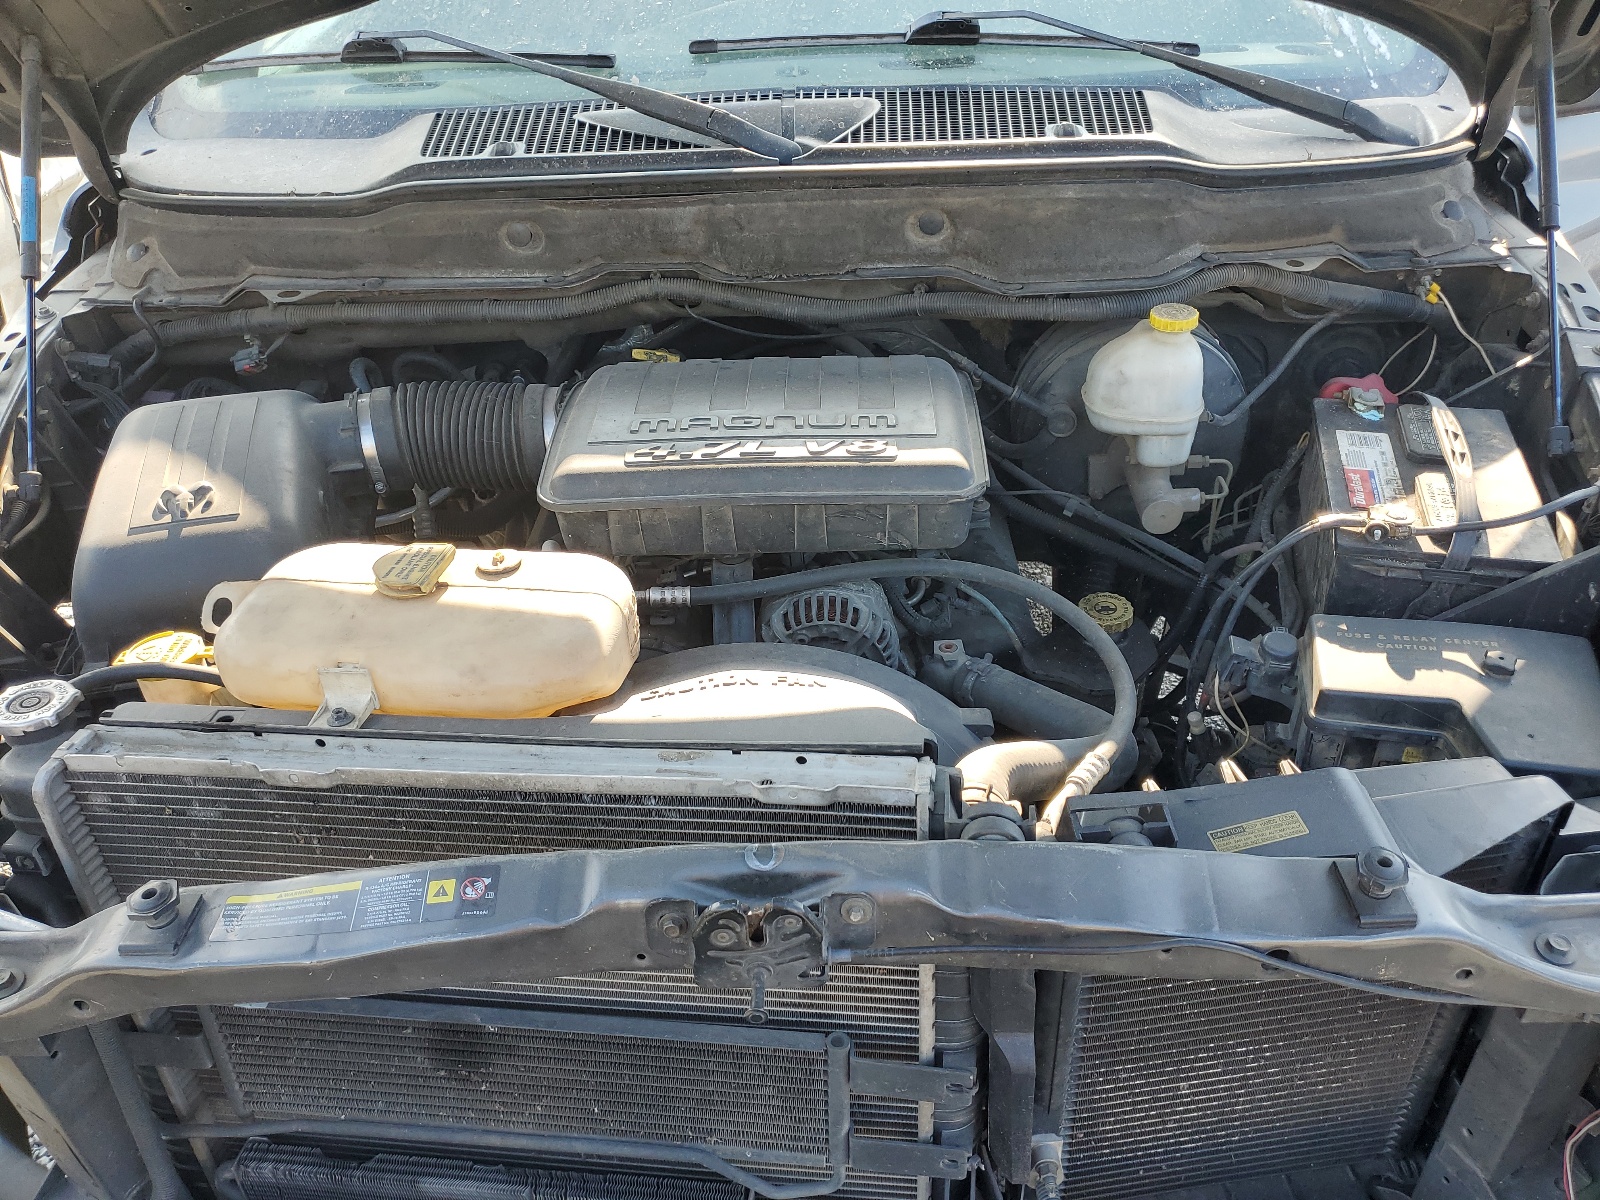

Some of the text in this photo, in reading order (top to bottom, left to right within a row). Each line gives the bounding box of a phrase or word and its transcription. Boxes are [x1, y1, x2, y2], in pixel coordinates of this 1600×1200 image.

[630, 414, 898, 434] MAGNUM
[634, 439, 889, 459] 4.7L V8
[1348, 473, 1366, 506] Duralast
[1376, 642, 1438, 651] CAUTION
[1394, 634, 1437, 642] RELAY
[1444, 638, 1499, 647] CENTER
[1212, 826, 1244, 839] CAUTION
[378, 874, 410, 883] ATTENTION
[284, 888, 314, 898] WARNING
